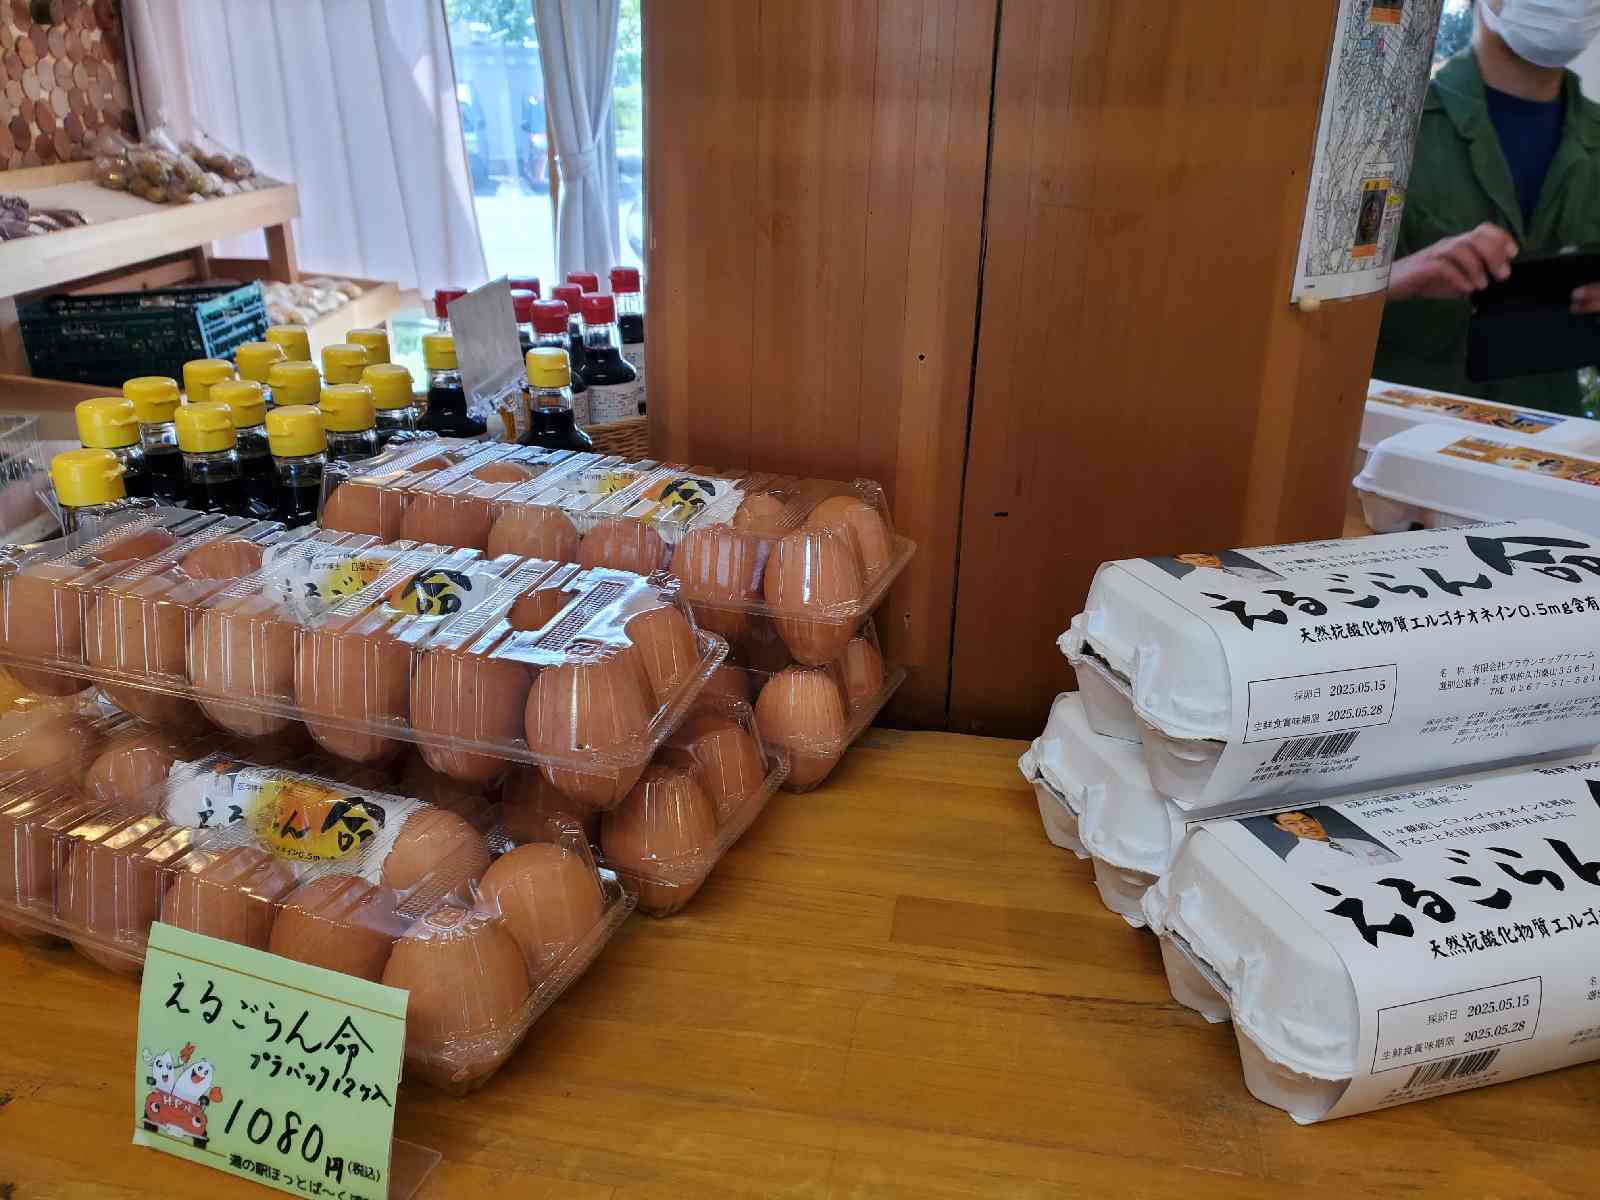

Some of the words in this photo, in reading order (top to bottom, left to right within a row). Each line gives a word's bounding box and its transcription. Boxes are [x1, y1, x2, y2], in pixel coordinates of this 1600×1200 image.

[1201, 535, 1600, 631] えるごらん命
[1299, 595, 1600, 644] 天然抗酸化物質エルゴチオネイン0.5mg含有
[1329, 679, 1387, 698] 2025.05.15
[1327, 703, 1384, 722] 2025.05.28
[1466, 994, 1530, 1018] 2025.05.15
[165, 972, 374, 1079] えるごらん命
[1463, 1020, 1527, 1043] 2025.05.28
